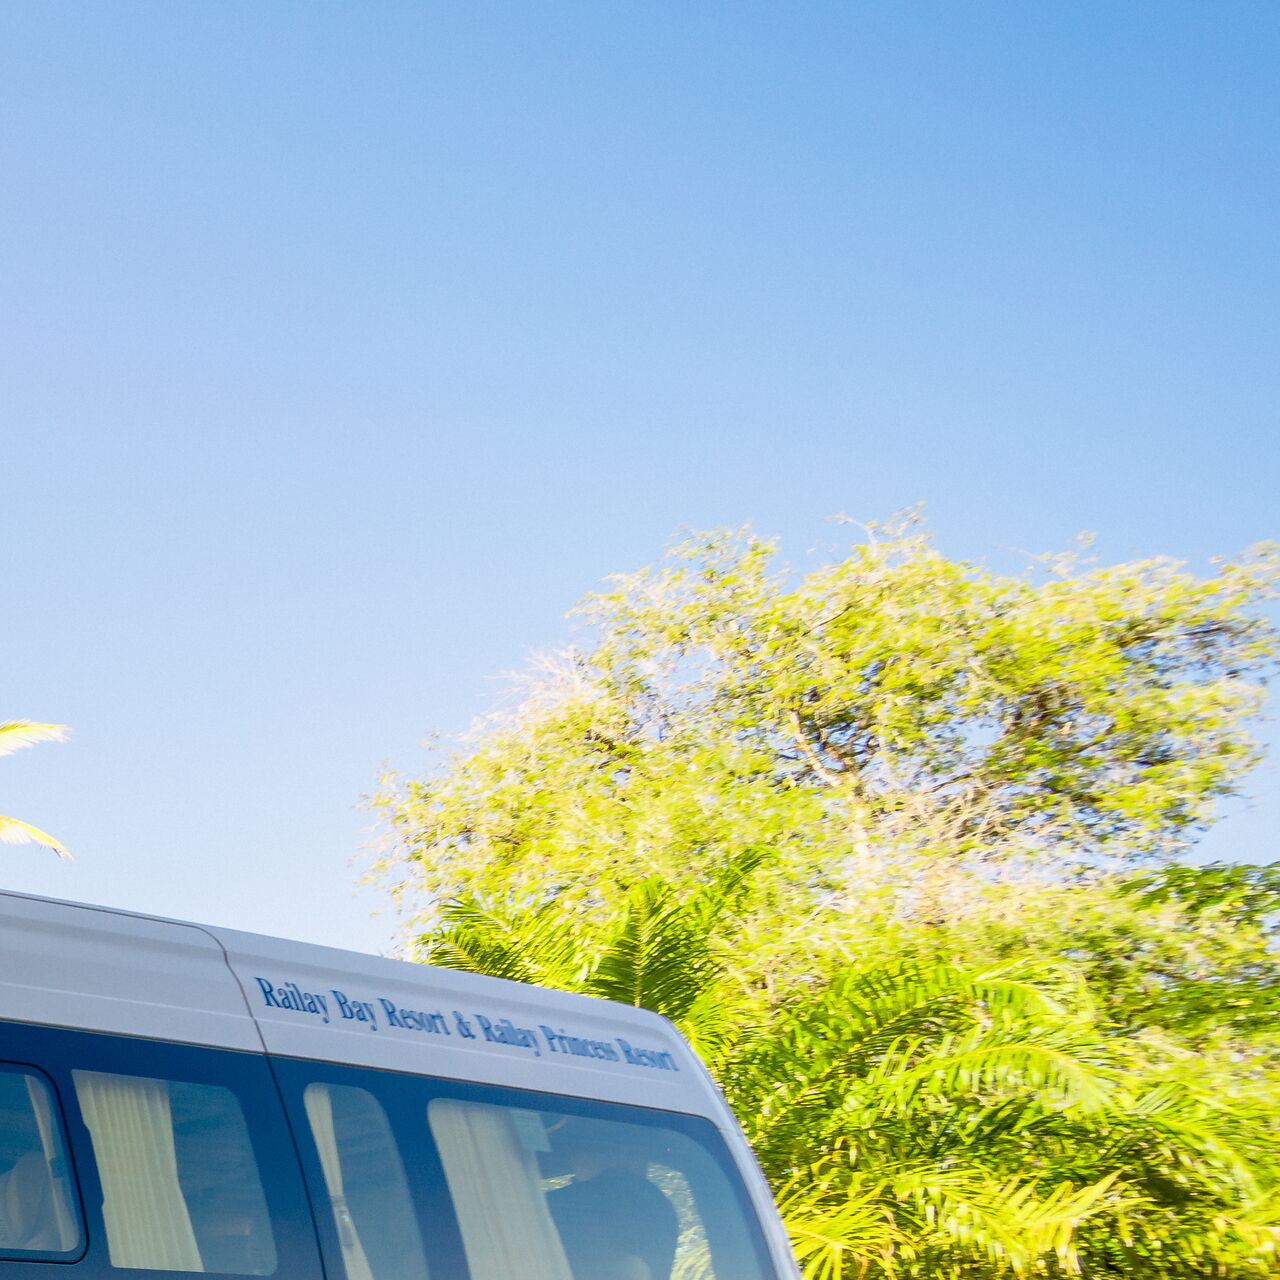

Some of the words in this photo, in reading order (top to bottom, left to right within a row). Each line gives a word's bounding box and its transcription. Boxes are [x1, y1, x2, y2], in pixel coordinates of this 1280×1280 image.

[255, 977, 328, 1023] Railay
[330, 989, 378, 1032] Bay
[379, 998, 450, 1036] Resort
[452, 1010, 476, 1039] &
[477, 1014, 541, 1057] Railay
[540, 1025, 620, 1062] Princess
[615, 1038, 680, 1072] Resort
